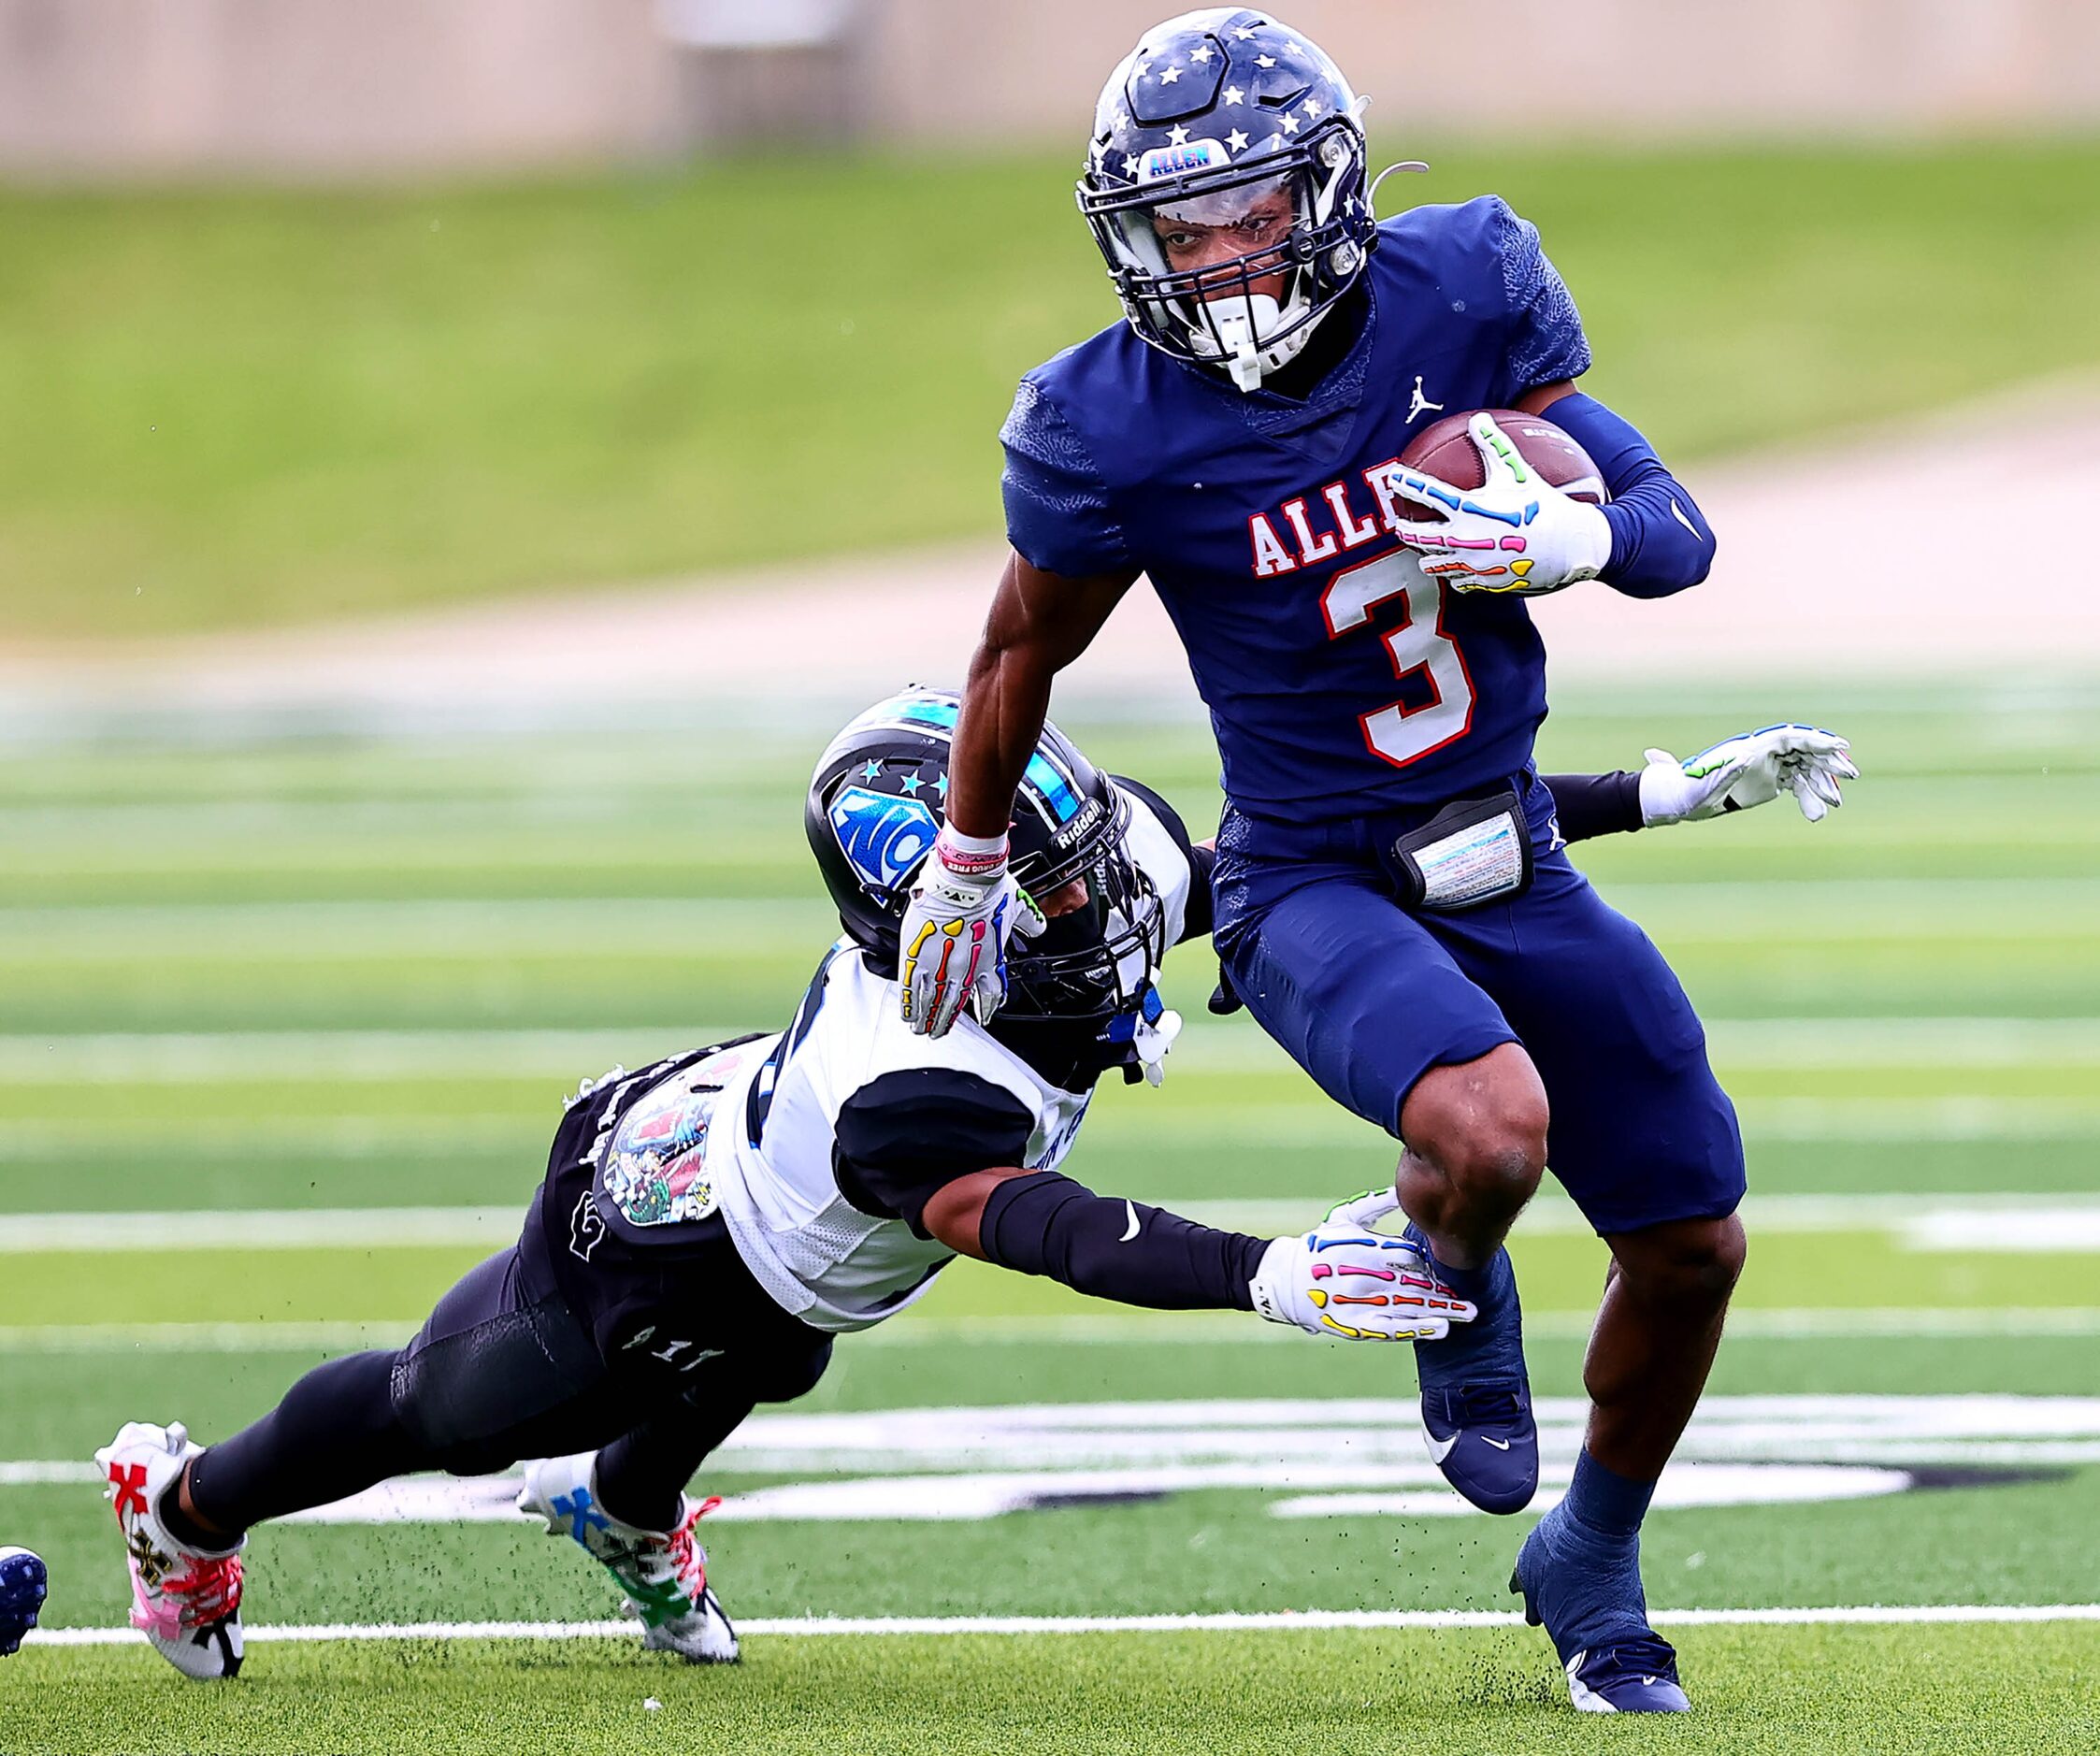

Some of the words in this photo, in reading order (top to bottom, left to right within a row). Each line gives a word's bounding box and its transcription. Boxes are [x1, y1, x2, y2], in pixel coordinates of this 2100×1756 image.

[1149, 142, 1213, 179] ALLEN
[1319, 545, 1477, 769] 3
[1057, 799, 1101, 850] Riddell
[946, 861, 971, 873] FREE
